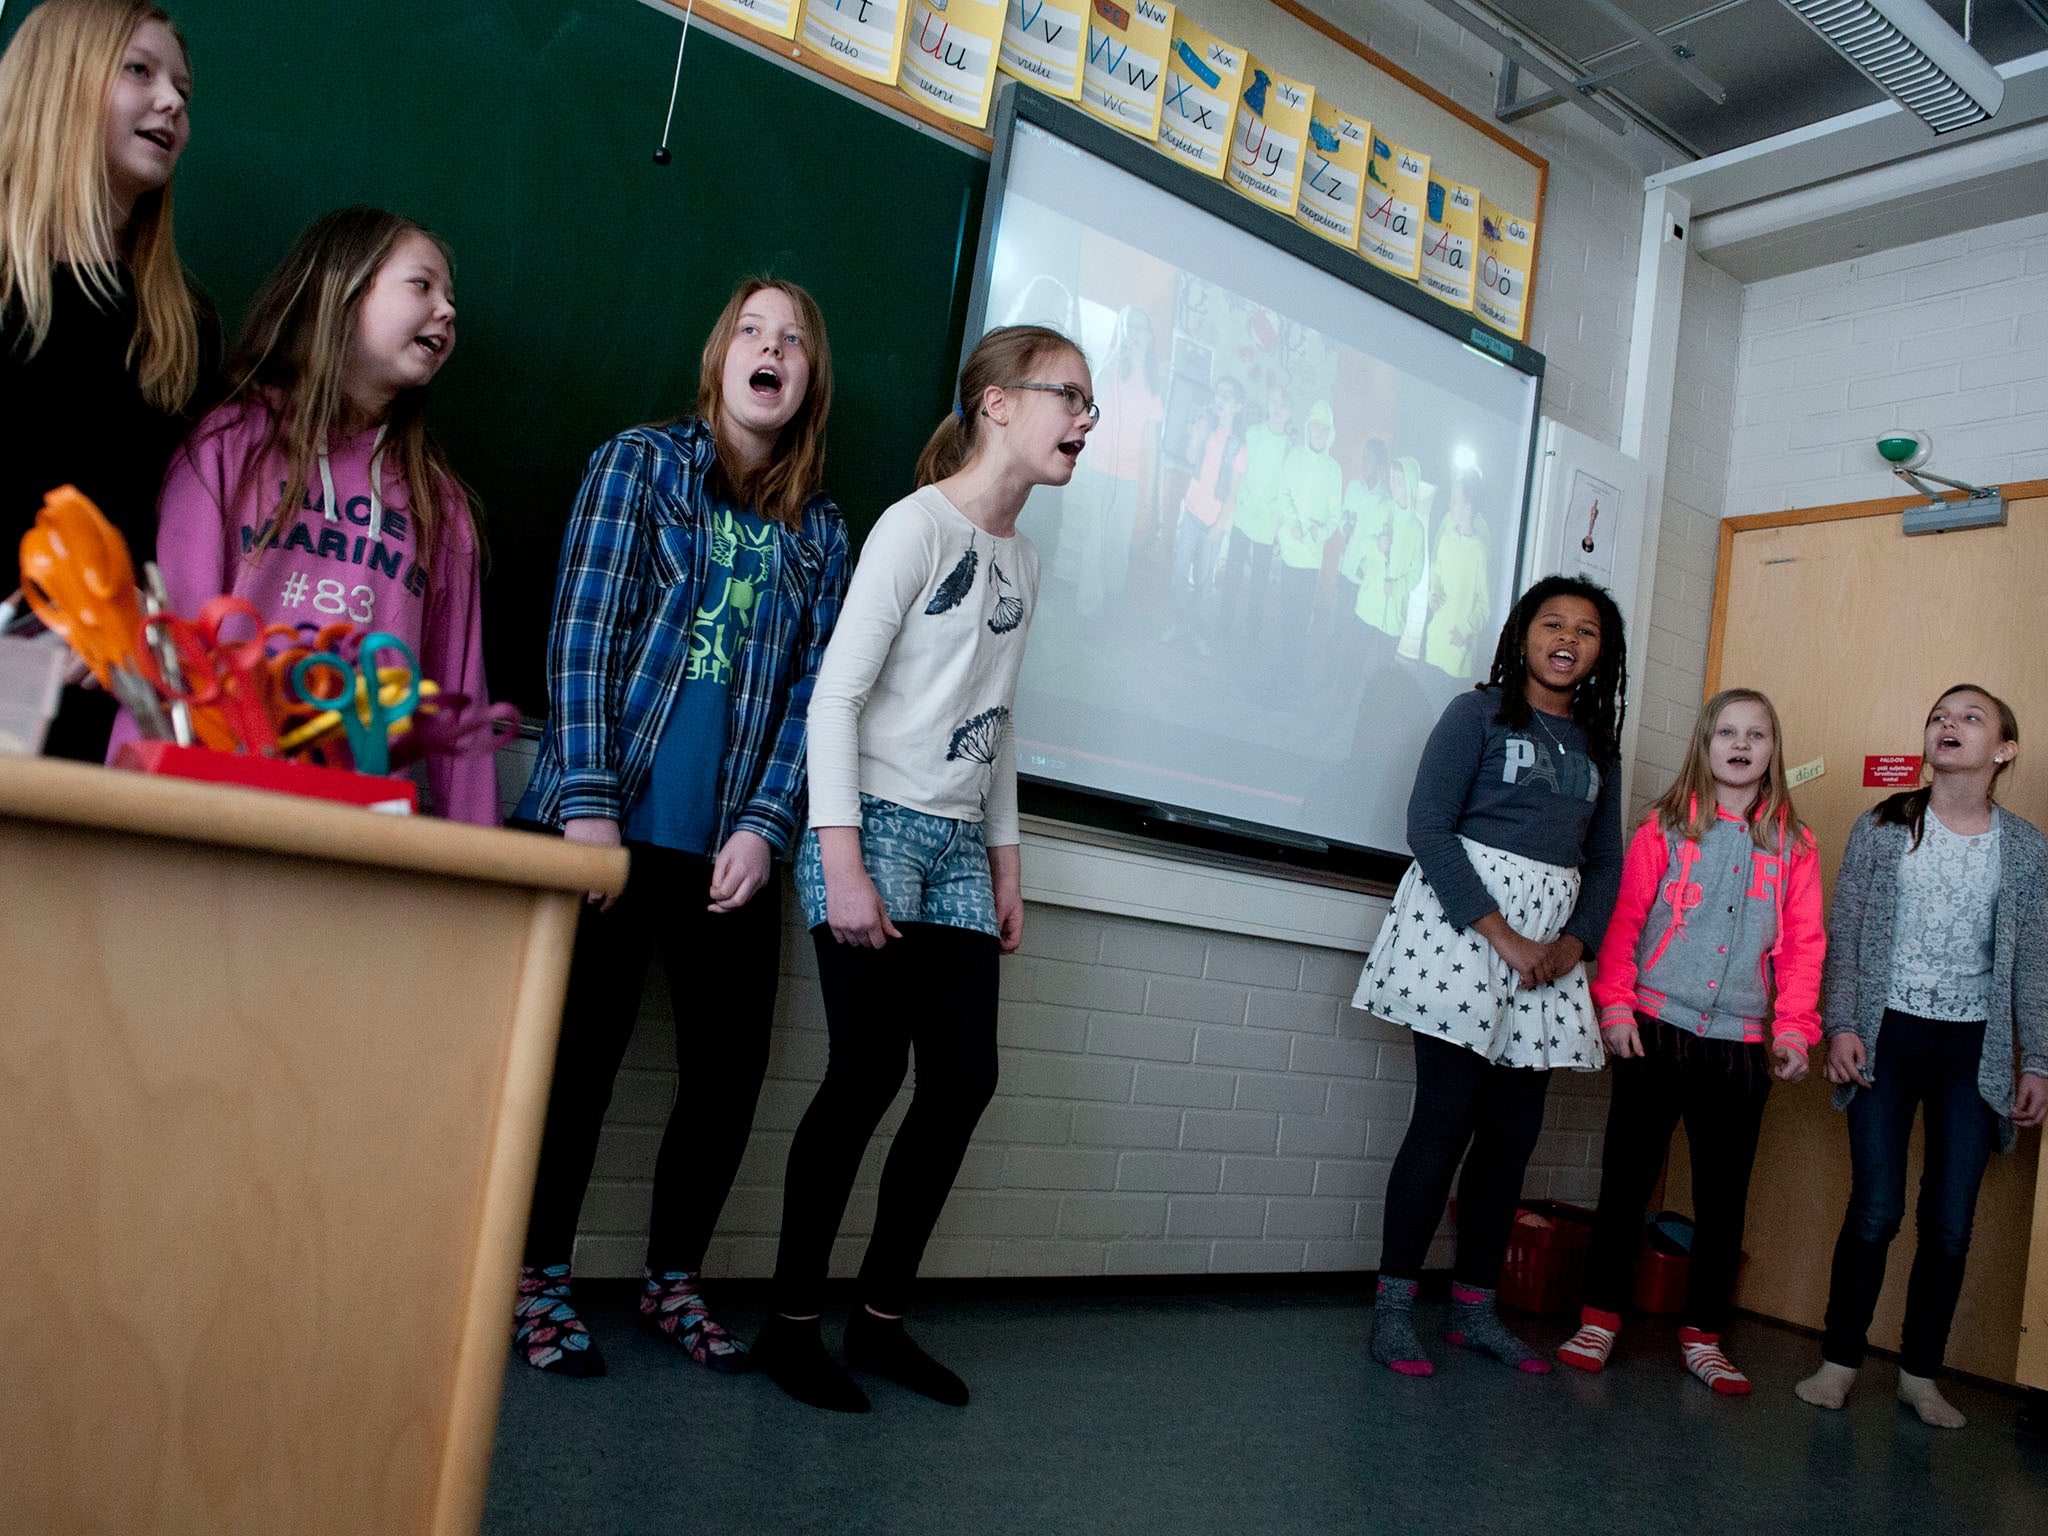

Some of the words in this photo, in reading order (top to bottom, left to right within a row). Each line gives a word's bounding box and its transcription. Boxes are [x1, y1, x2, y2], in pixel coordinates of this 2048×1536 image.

[1137, 0, 1167, 24] Ww
[829, 34, 859, 58] talo
[1018, 54, 1051, 79] viulu
[919, 78, 954, 104] uuni
[1103, 92, 1129, 117] WC
[281, 571, 376, 624] #83
